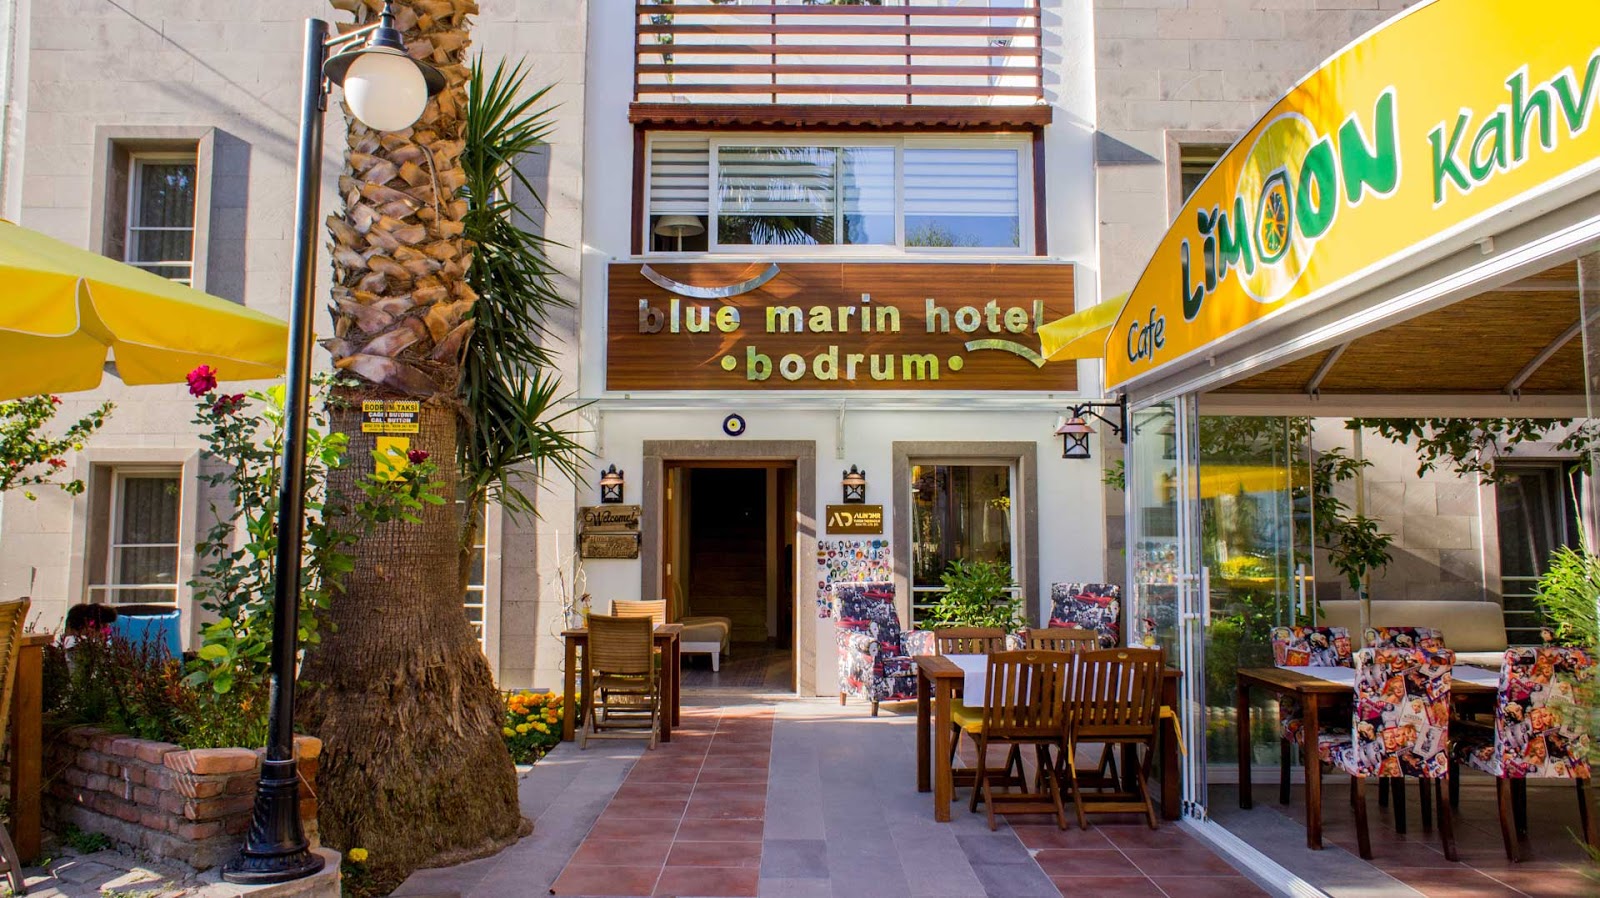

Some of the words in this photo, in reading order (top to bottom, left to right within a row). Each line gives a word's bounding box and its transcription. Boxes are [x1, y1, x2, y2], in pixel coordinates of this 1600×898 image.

[638, 298, 741, 334] blue
[766, 293, 901, 333] marin
[925, 298, 1044, 334] hotel
[1127, 306, 1165, 364] Cafe
[746, 345, 939, 381] bodrum
